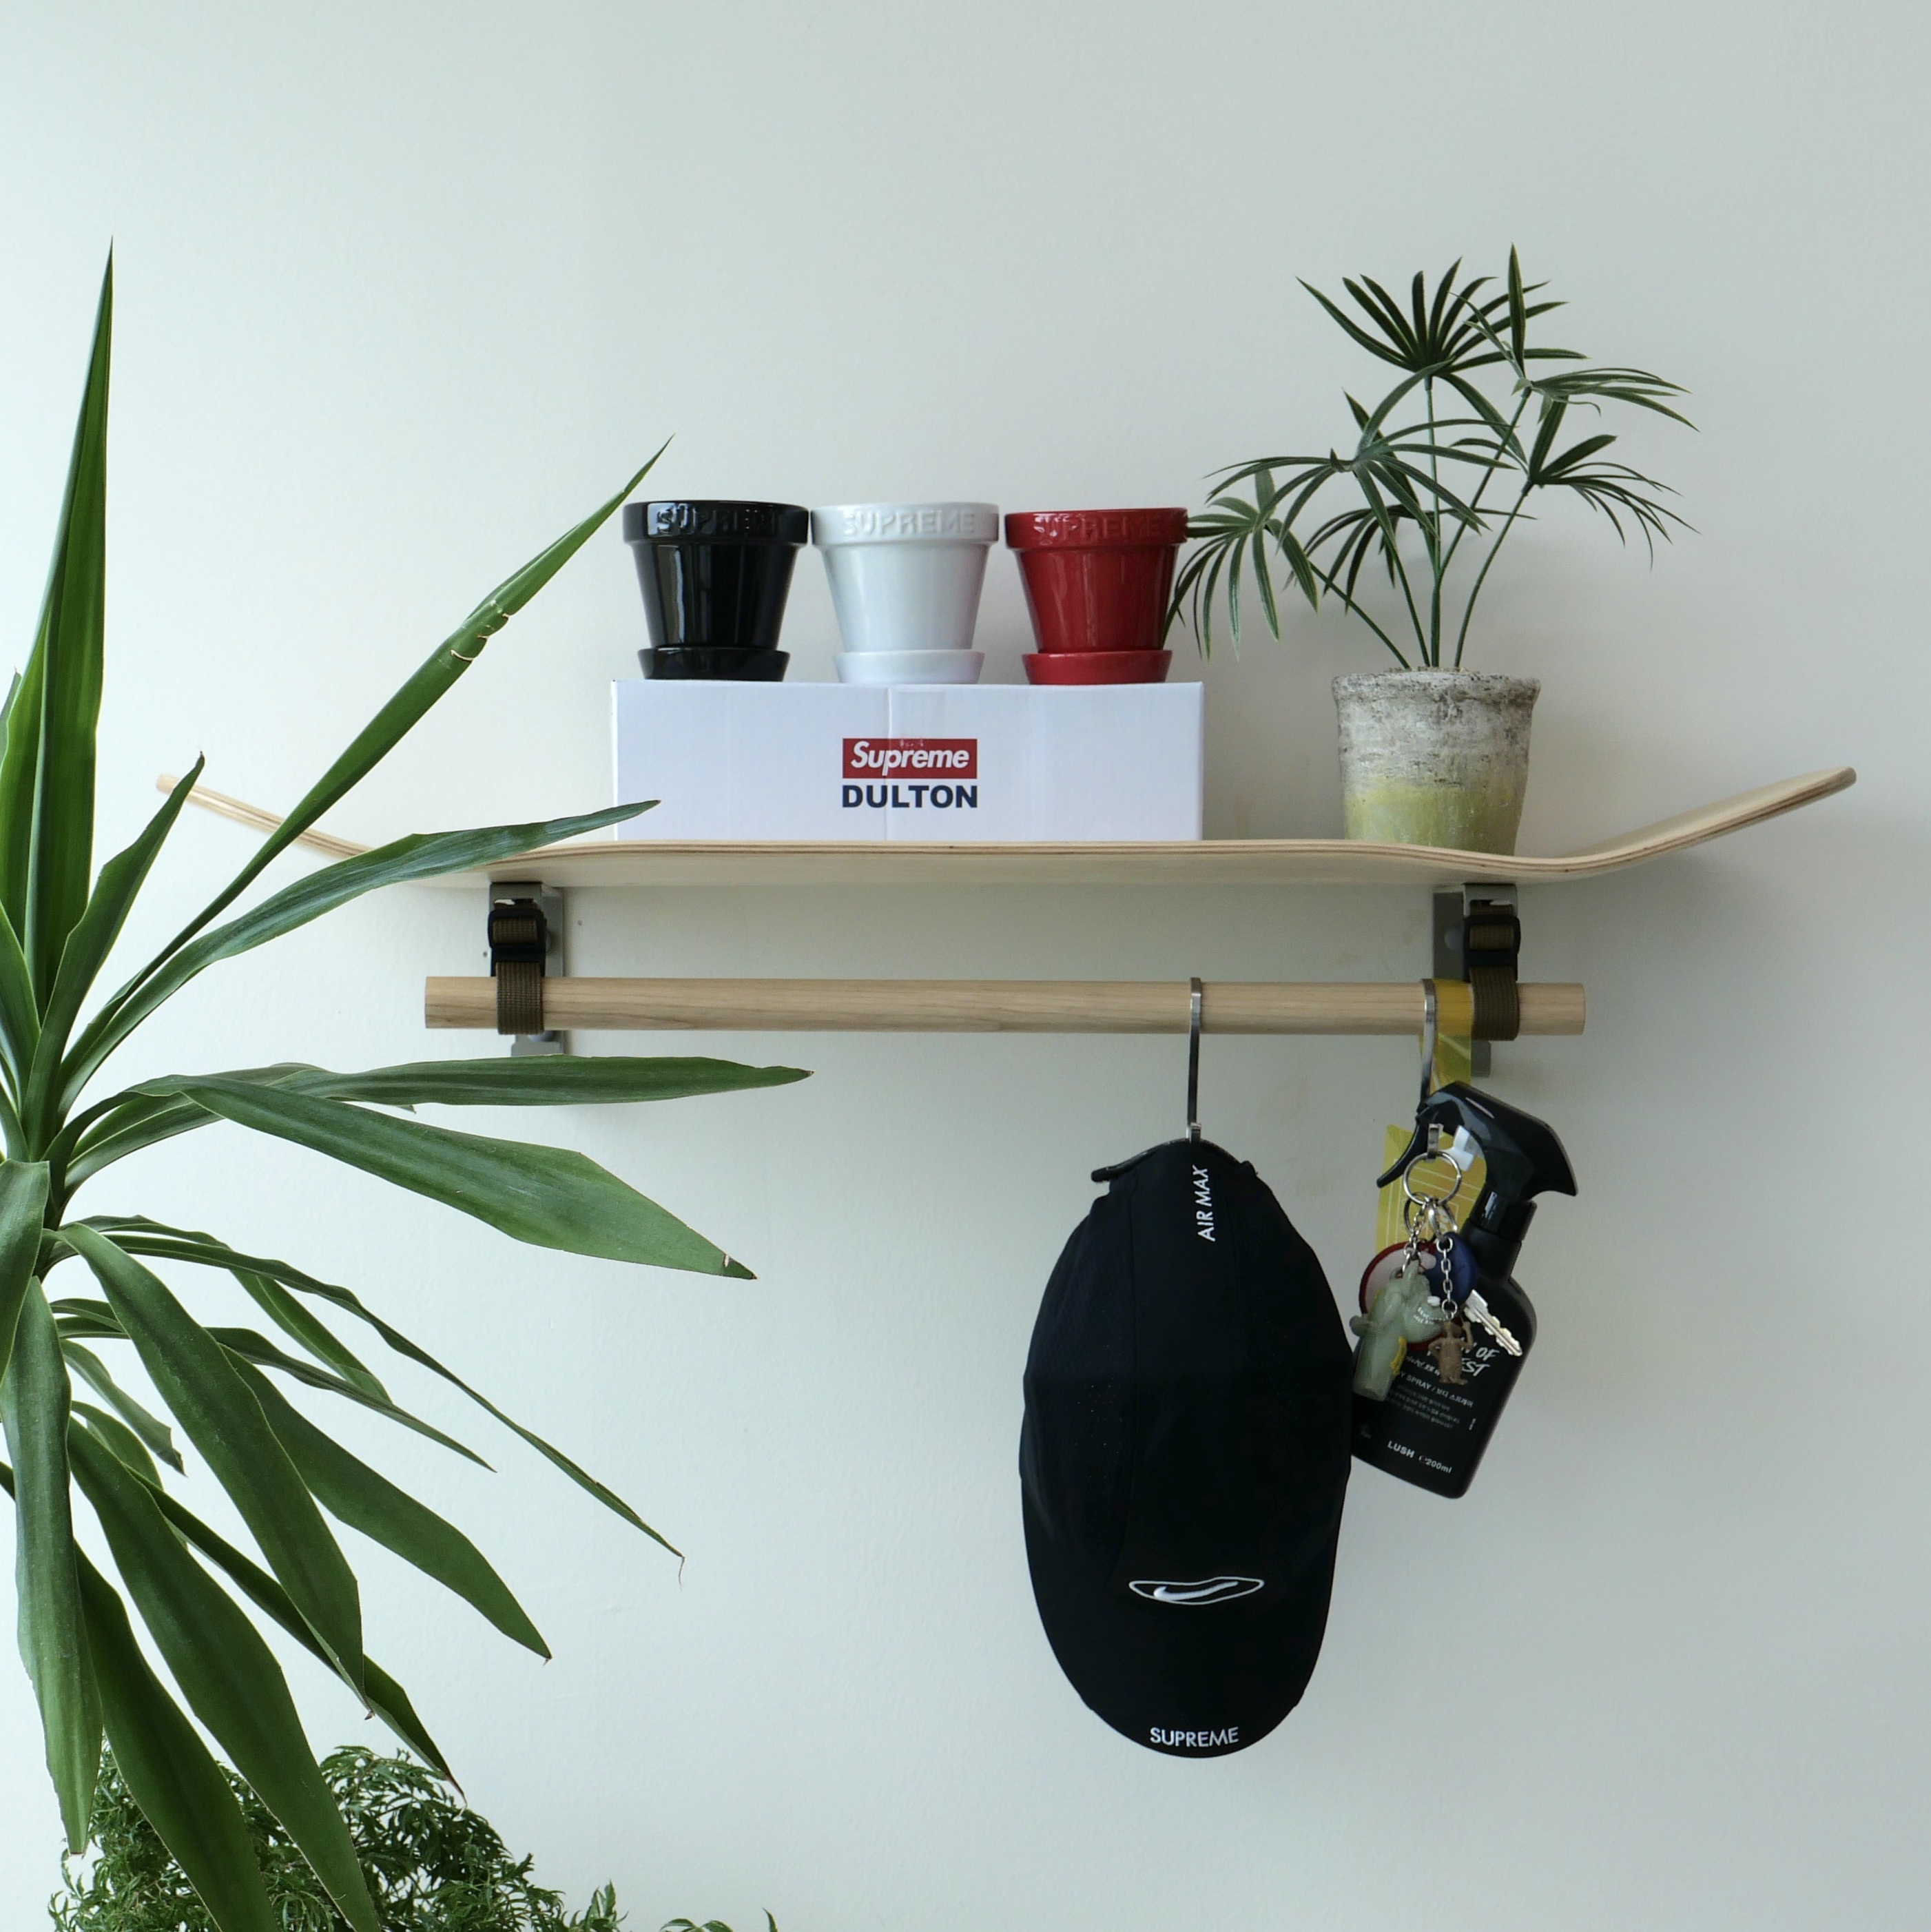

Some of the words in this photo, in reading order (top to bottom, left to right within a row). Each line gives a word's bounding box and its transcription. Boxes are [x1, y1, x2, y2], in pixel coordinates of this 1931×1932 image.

[843, 510, 975, 536] SUPREME
[850, 741, 970, 777] Supreme
[842, 785, 978, 808] DULTON
[1192, 1164, 1212, 1207] MAX
[1196, 1210, 1216, 1242] AIR
[1476, 1347, 1500, 1361] OF
[1387, 1440, 1415, 1458] LUSH
[1149, 1727, 1239, 1747] SUPREME
